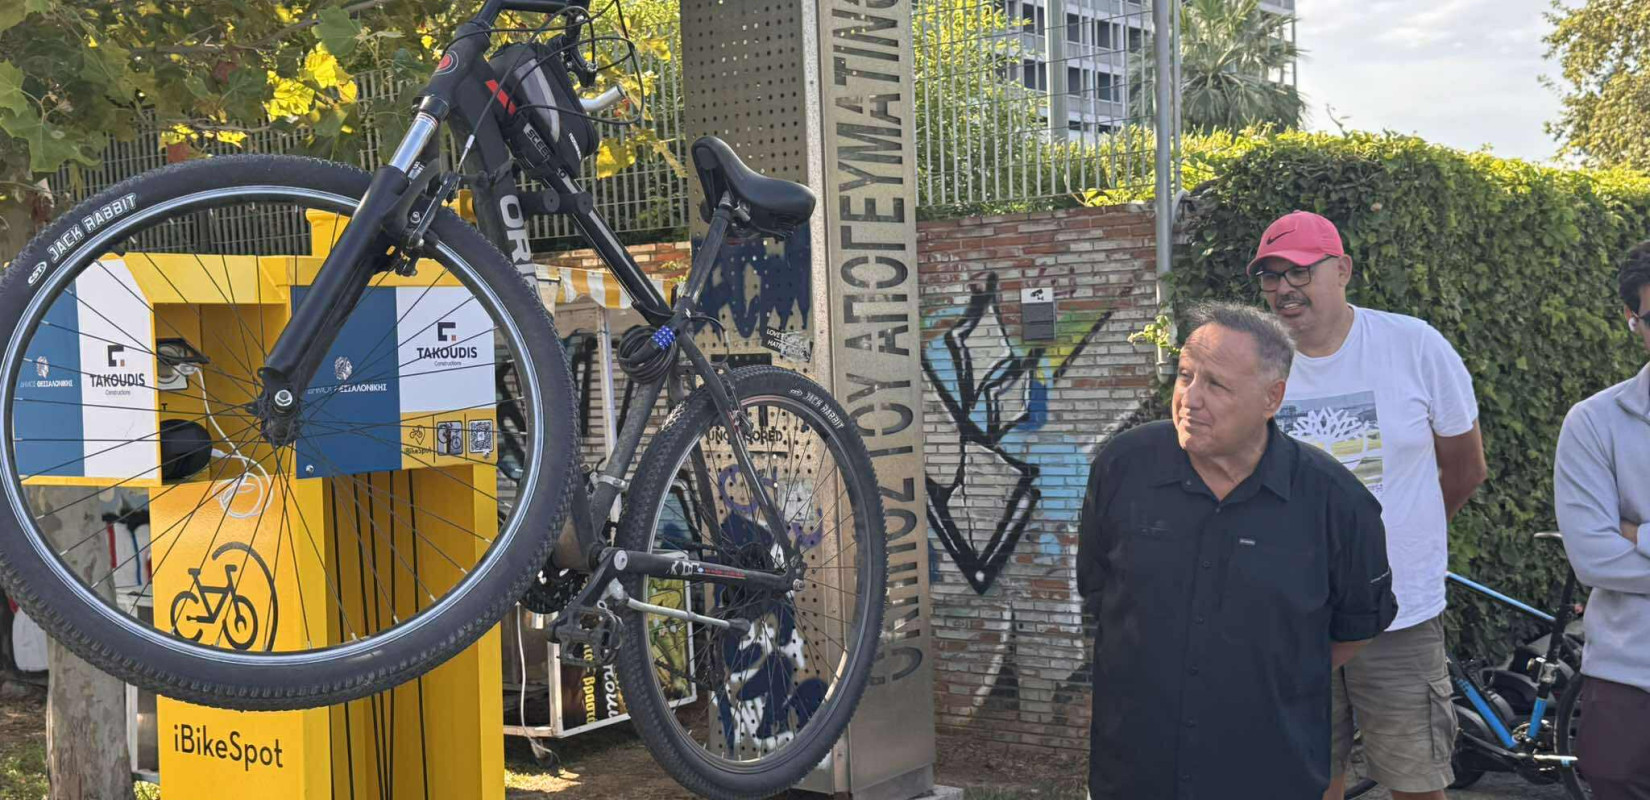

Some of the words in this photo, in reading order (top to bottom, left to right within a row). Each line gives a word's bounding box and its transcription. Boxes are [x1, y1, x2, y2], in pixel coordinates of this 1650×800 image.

[48, 226, 84, 262] JACK
[84, 194, 136, 233] RABBIT
[766, 328, 780, 339] LOVE
[417, 347, 477, 359] TAKOUDIS
[90, 373, 145, 387] TAKOUDIS
[804, 390, 822, 410] JACK
[821, 402, 845, 430] RABBIT
[174, 724, 283, 772] iBikeSpot
